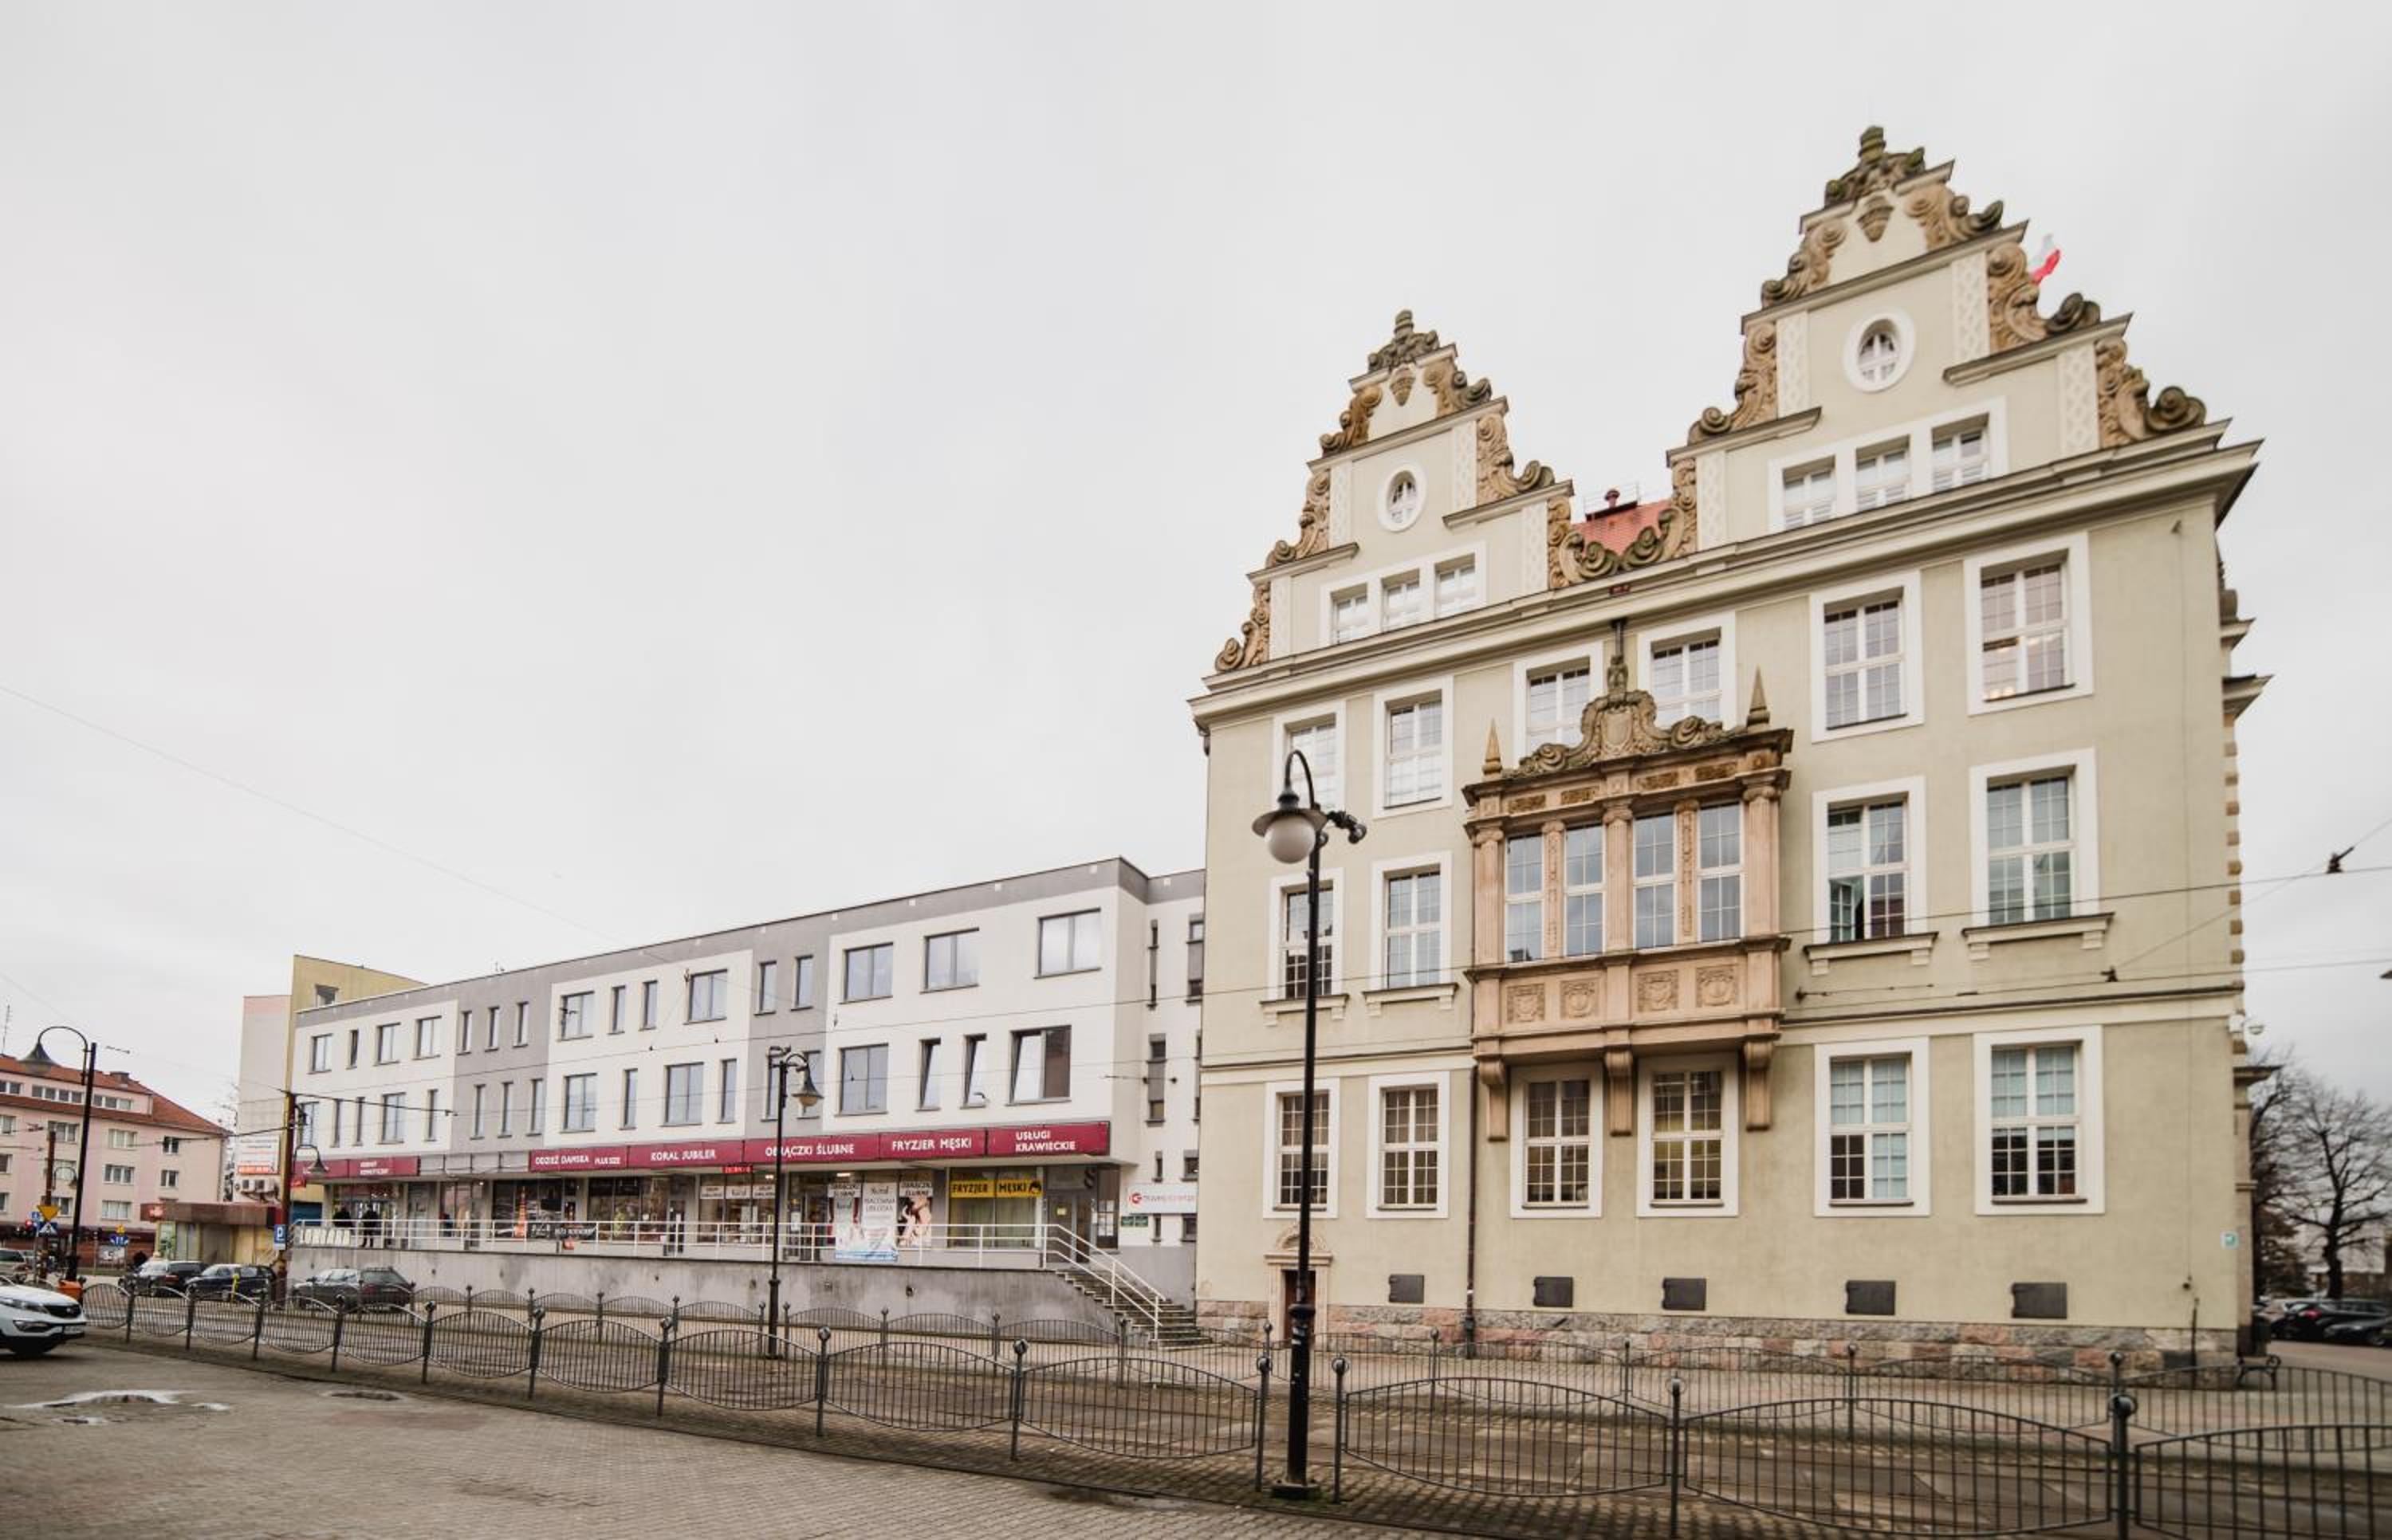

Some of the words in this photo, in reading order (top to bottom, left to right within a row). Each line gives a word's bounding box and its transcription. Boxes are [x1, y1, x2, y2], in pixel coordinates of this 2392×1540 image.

[1015, 1131, 1050, 1141] USŁUGI
[765, 1145, 812, 1157] OBĄCZKI
[816, 1143, 855, 1155] ŚLUBNE
[891, 1140, 934, 1151] FRYZJER
[939, 1137, 972, 1151] MĘSKI
[1015, 1141, 1076, 1153] KRAWIECKIE
[561, 1155, 589, 1164] DAMSKA
[651, 1152, 679, 1161] KORAL
[683, 1149, 715, 1160] JUBILER
[952, 1183, 989, 1194] FRYZJER
[998, 1181, 1028, 1193] MĘSKI
